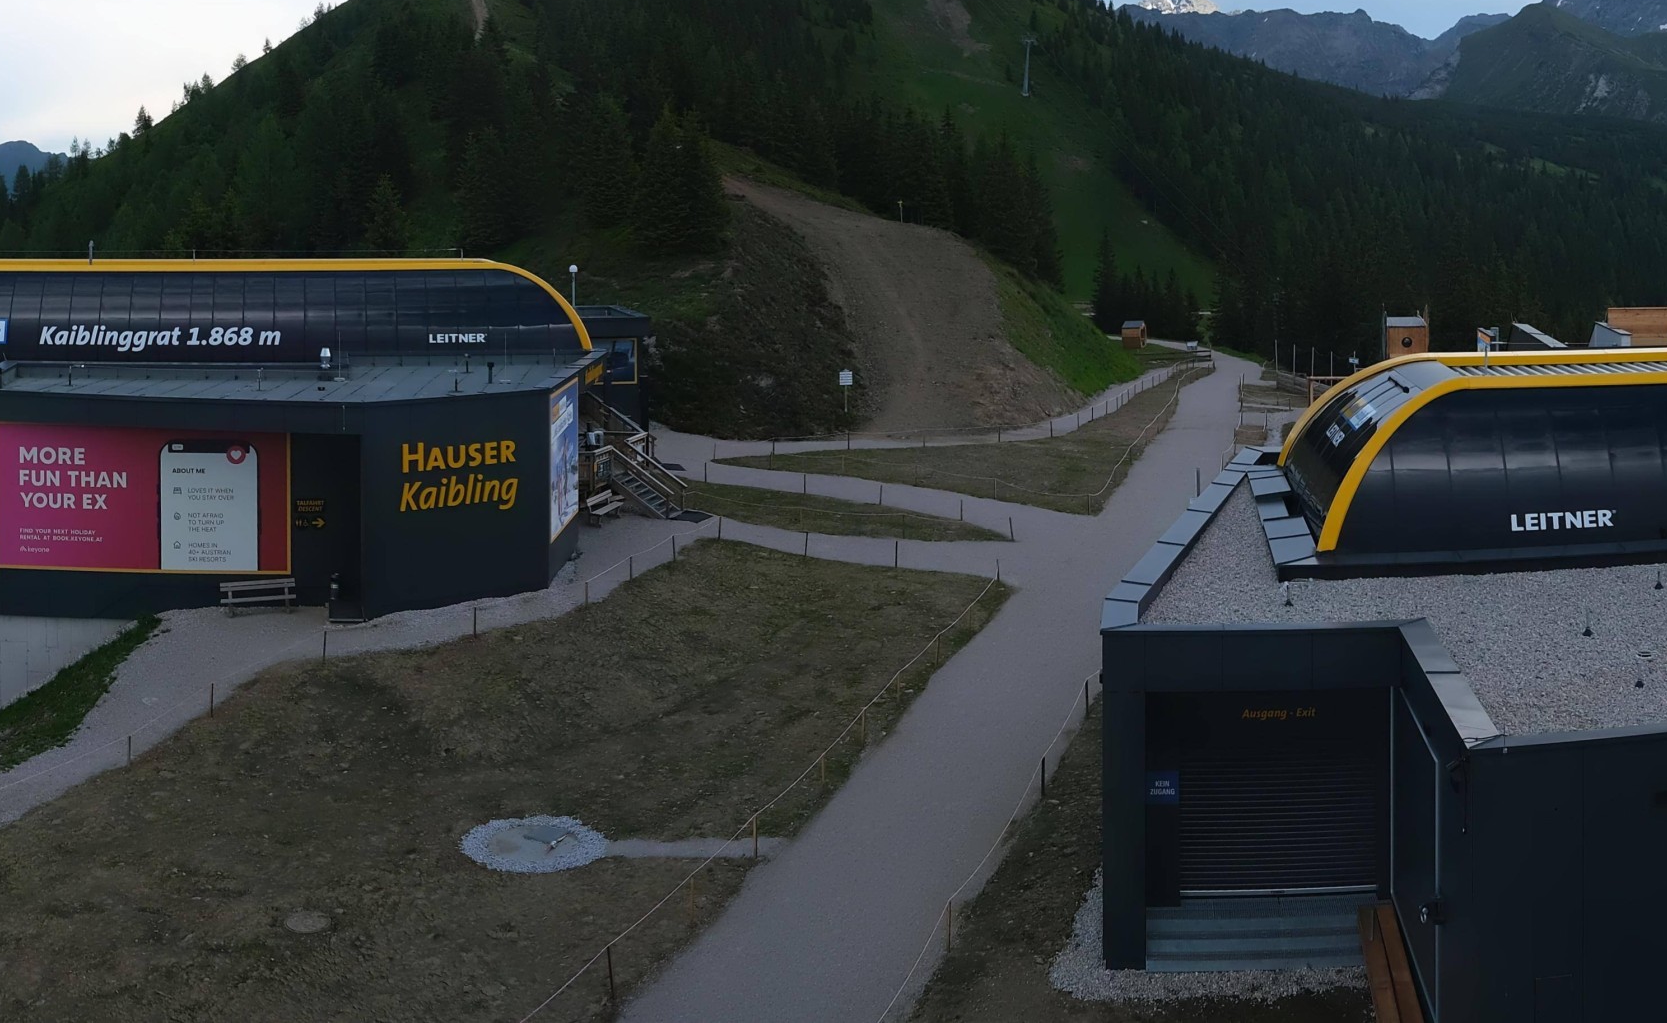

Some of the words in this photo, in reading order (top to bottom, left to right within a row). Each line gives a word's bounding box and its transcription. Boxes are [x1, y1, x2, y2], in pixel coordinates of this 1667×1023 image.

[39, 325, 181, 352] Kaiblinggrat
[186, 327, 252, 346] 1.868
[258, 330, 281, 346] m
[429, 333, 487, 343] LEITNER
[19, 447, 86, 465] MORE
[402, 440, 516, 473] HAUSER
[19, 470, 60, 487] FUN
[67, 471, 127, 488] THAN
[20, 492, 76, 509] YOUR
[82, 494, 108, 510] EX
[400, 474, 518, 512] Kaibling
[1241, 708, 1287, 720] Ausgang
[1296, 706, 1316, 717] Exit
